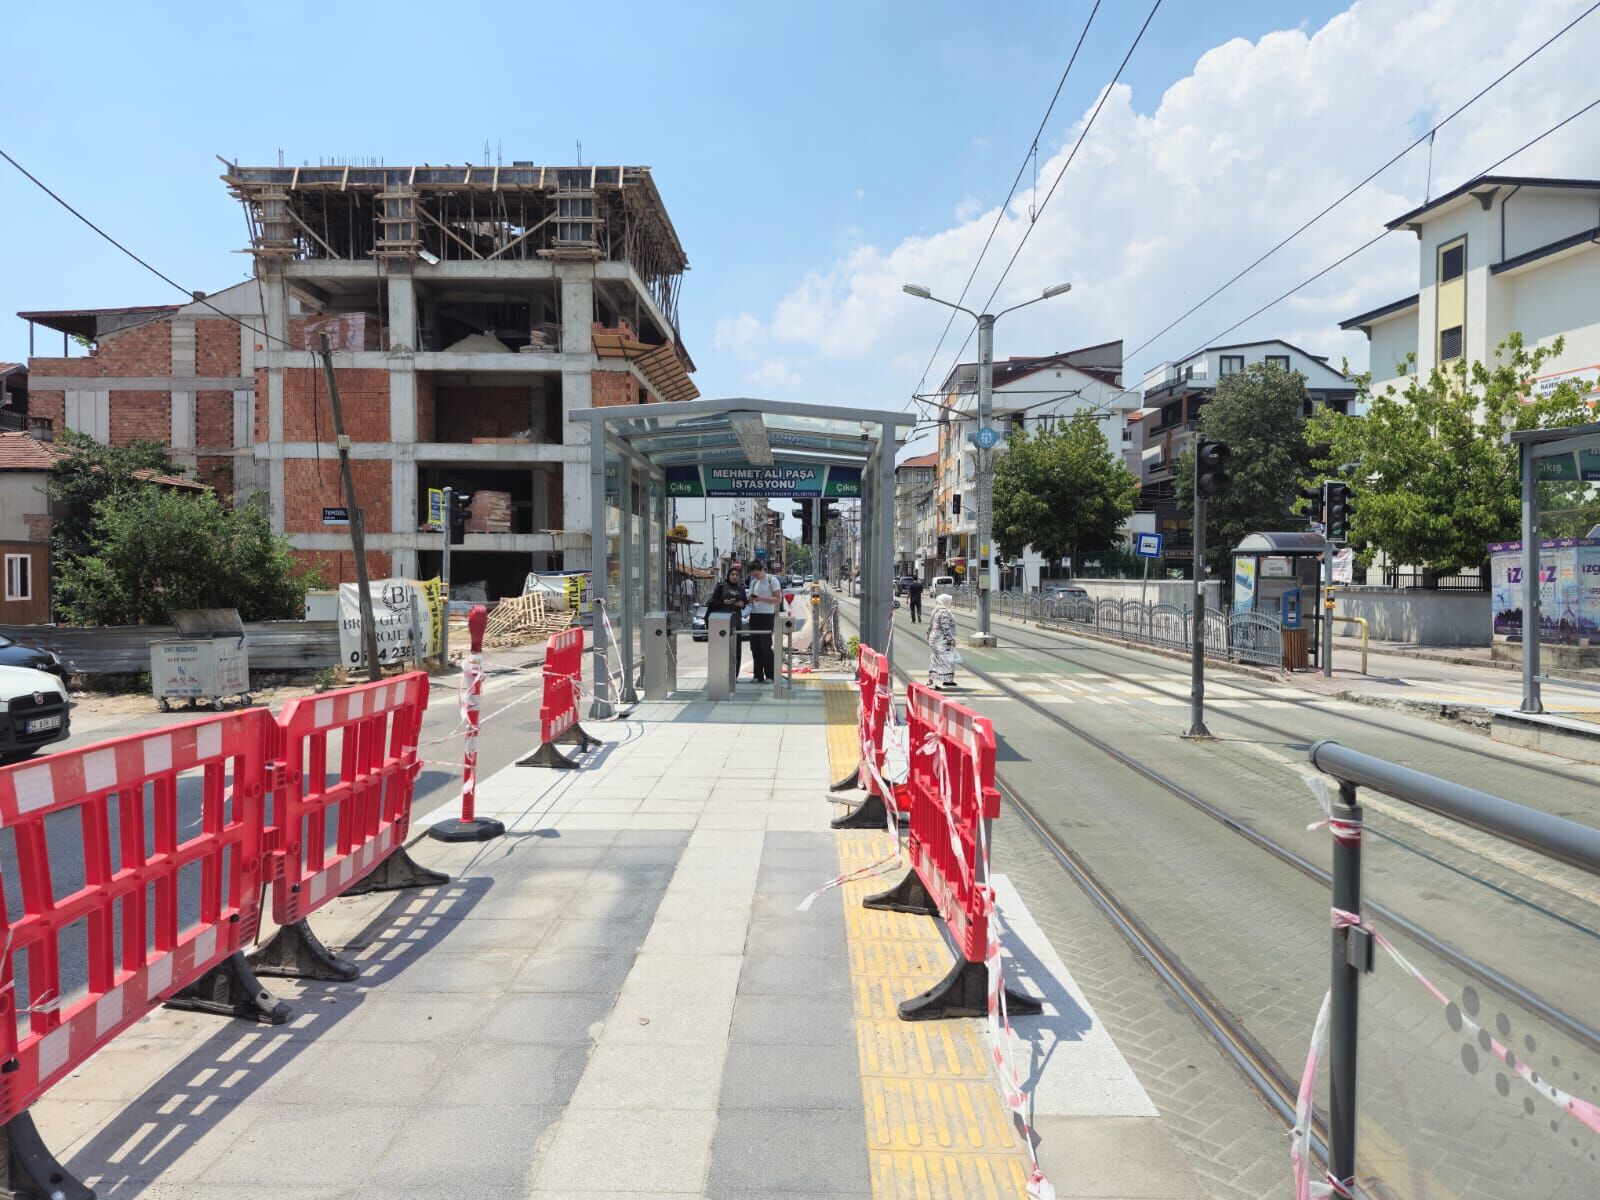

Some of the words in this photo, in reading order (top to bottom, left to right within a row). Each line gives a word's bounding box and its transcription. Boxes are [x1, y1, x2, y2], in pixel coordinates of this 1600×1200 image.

[713, 469, 761, 478] MEHMET
[764, 467, 782, 478] ALİ
[785, 469, 815, 480] PAŞA
[670, 483, 692, 493] Çıkış
[731, 478, 796, 489] İSTASYONU
[836, 483, 858, 493] Çıkış
